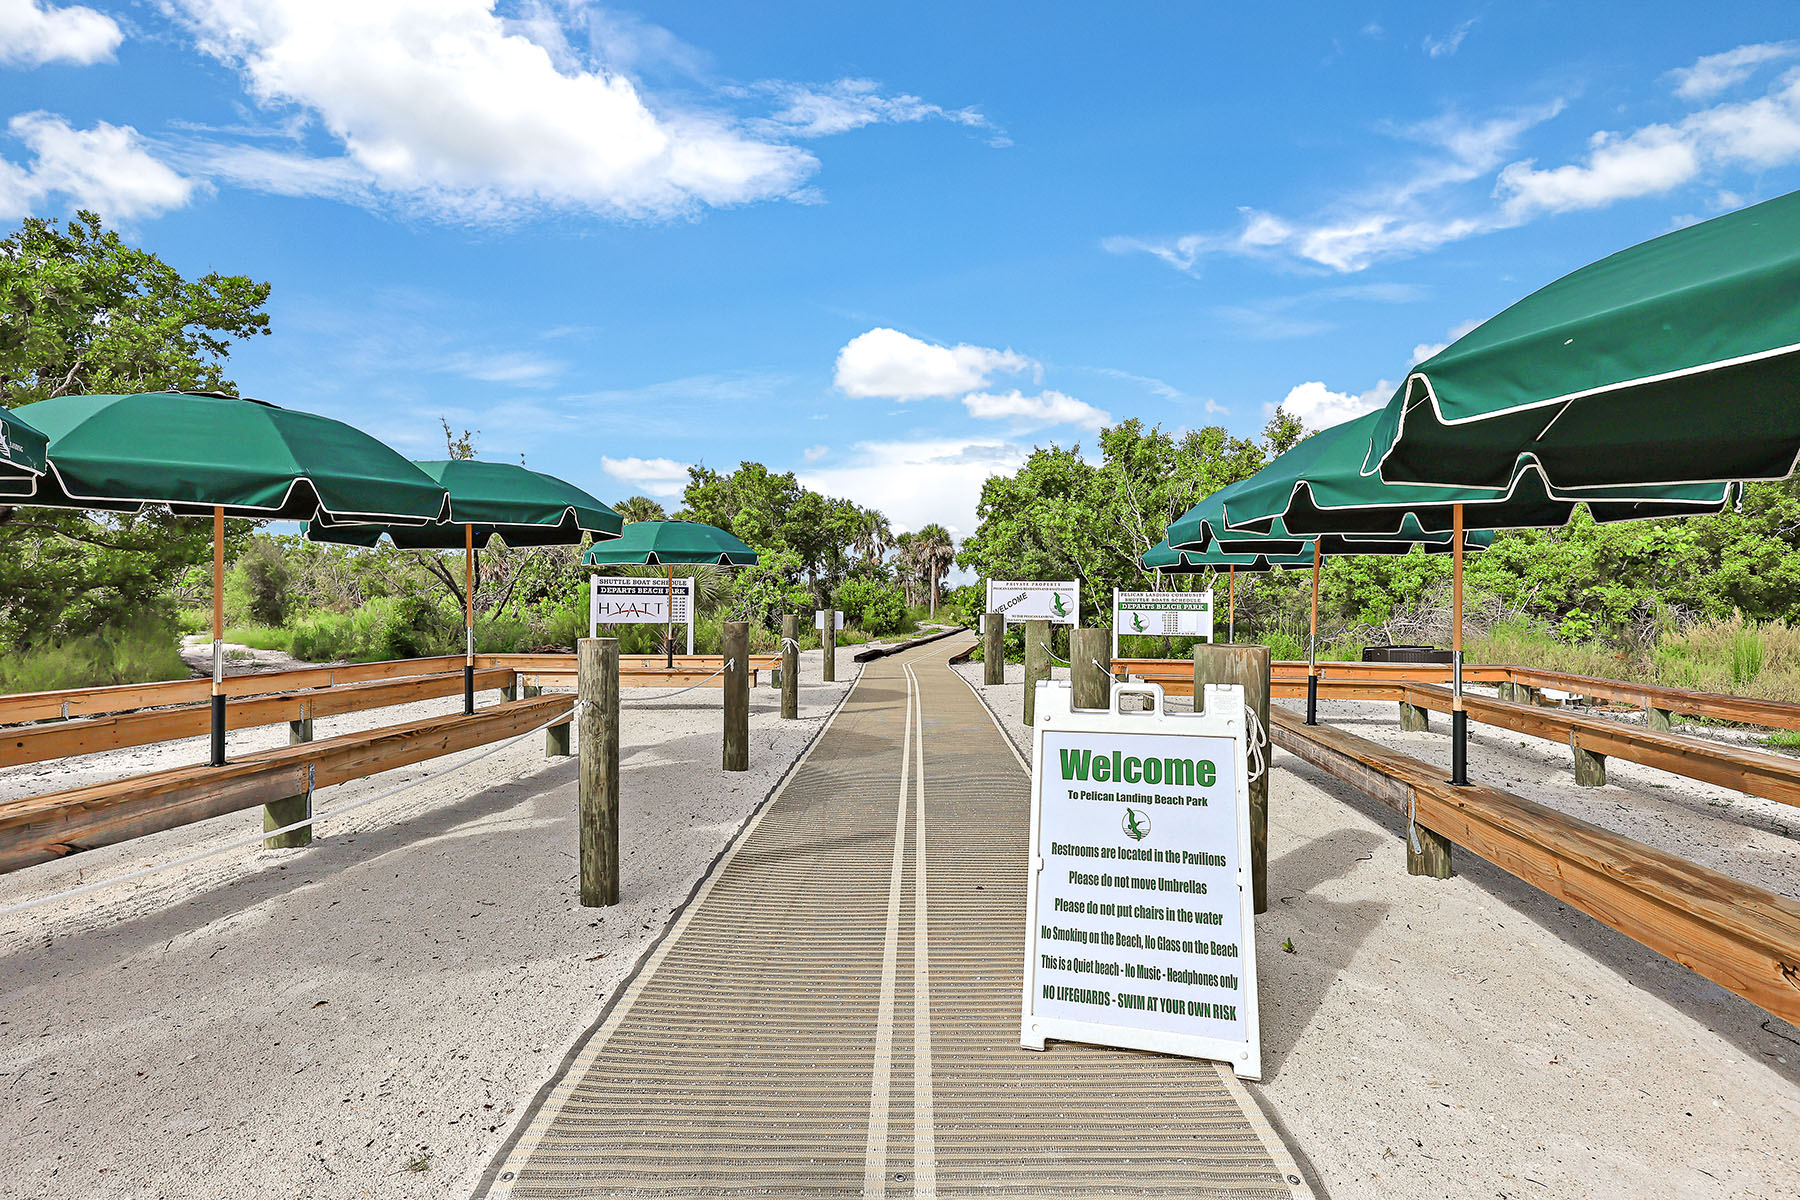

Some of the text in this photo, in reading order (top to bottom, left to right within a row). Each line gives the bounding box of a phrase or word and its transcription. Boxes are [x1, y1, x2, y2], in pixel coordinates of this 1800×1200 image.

[599, 602, 664, 618] HYATT
[992, 592, 1028, 614] WELCOME
[1060, 749, 1216, 787] Welcome
[1068, 790, 1208, 806] To Pelican Landing Beach Park
[1052, 842, 1226, 867] Restrooms are located in the Pavilions
[1069, 871, 1207, 894] Please do not move Umbrellas
[1055, 898, 1223, 925] Please do not put chairs in the water
[1042, 925, 1238, 957] No Smoking on the Beach, No Glass on the Beach
[1042, 955, 1057, 969] This
[1059, 956, 1065, 970] is
[1067, 960, 1071, 971] a
[1074, 958, 1093, 973] Quiet
[1095, 960, 1119, 976] beach
[1125, 963, 1135, 978] No
[1137, 965, 1161, 980] Music
[1167, 968, 1218, 987] Headphones
[1220, 974, 1237, 990] only
[1043, 985, 1055, 999] NO
[1057, 986, 1110, 1006] LIFEGUARDS
[1118, 993, 1145, 1010] SWIM
[1147, 997, 1158, 1011] AT
[1160, 998, 1185, 1015] YOUR
[1188, 1001, 1210, 1018] OWN
[1213, 1004, 1236, 1021] RISK
